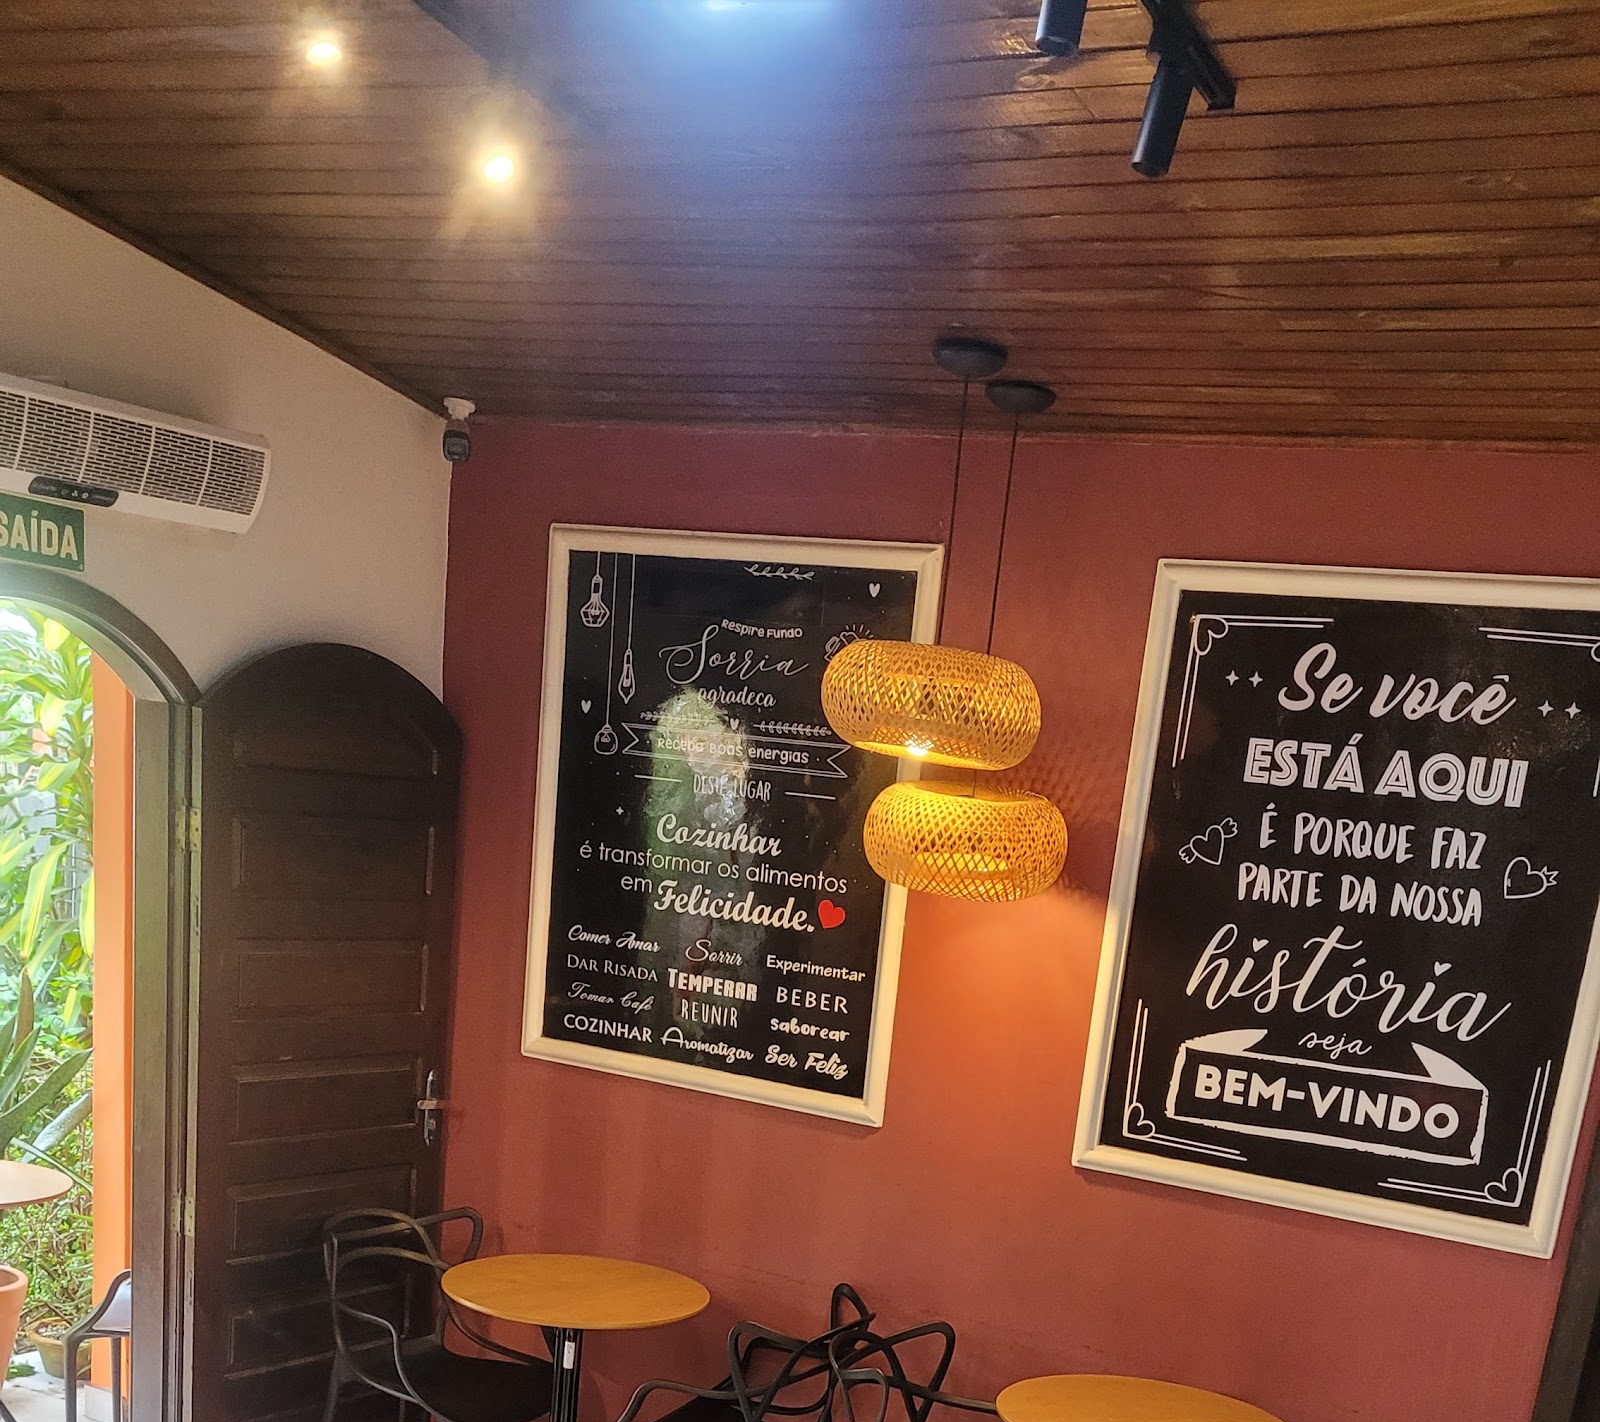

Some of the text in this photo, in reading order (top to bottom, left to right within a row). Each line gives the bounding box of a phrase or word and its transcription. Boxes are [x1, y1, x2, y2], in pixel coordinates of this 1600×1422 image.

[658, 624, 810, 685] Sorria
[698, 686, 777, 713] agradeça
[1278, 642, 1517, 726] Se você
[748, 747, 810, 764] energias
[1242, 734, 1529, 808] ESTÁ AQUI
[693, 773, 772, 801] DESTE LUGAR
[656, 813, 782, 857] Cozinhar
[1259, 803, 1488, 870] É PORQUE FAZ
[579, 841, 848, 894] é transformar os alimentos
[620, 876, 815, 933] em Felicidade.
[1238, 862, 1483, 927] PARTE DA NOSSA
[567, 924, 661, 953] Comer Amar
[685, 939, 743, 967] Sorrir
[667, 967, 758, 1002] TEMPERAR
[766, 954, 866, 983] Experimentar
[1186, 923, 1512, 1042] história
[567, 981, 655, 1014] Tomar Café
[681, 998, 738, 1029] REUNIR
[776, 986, 848, 1014] BEBER
[564, 1013, 653, 1043] COZINHAR
[660, 1026, 754, 1063] Aromatizar
[770, 1017, 850, 1042] saborear
[1298, 1030, 1373, 1059] seja
[764, 1044, 849, 1080] Ser Feliz
[1195, 1064, 1460, 1140] BEM-VINDO
